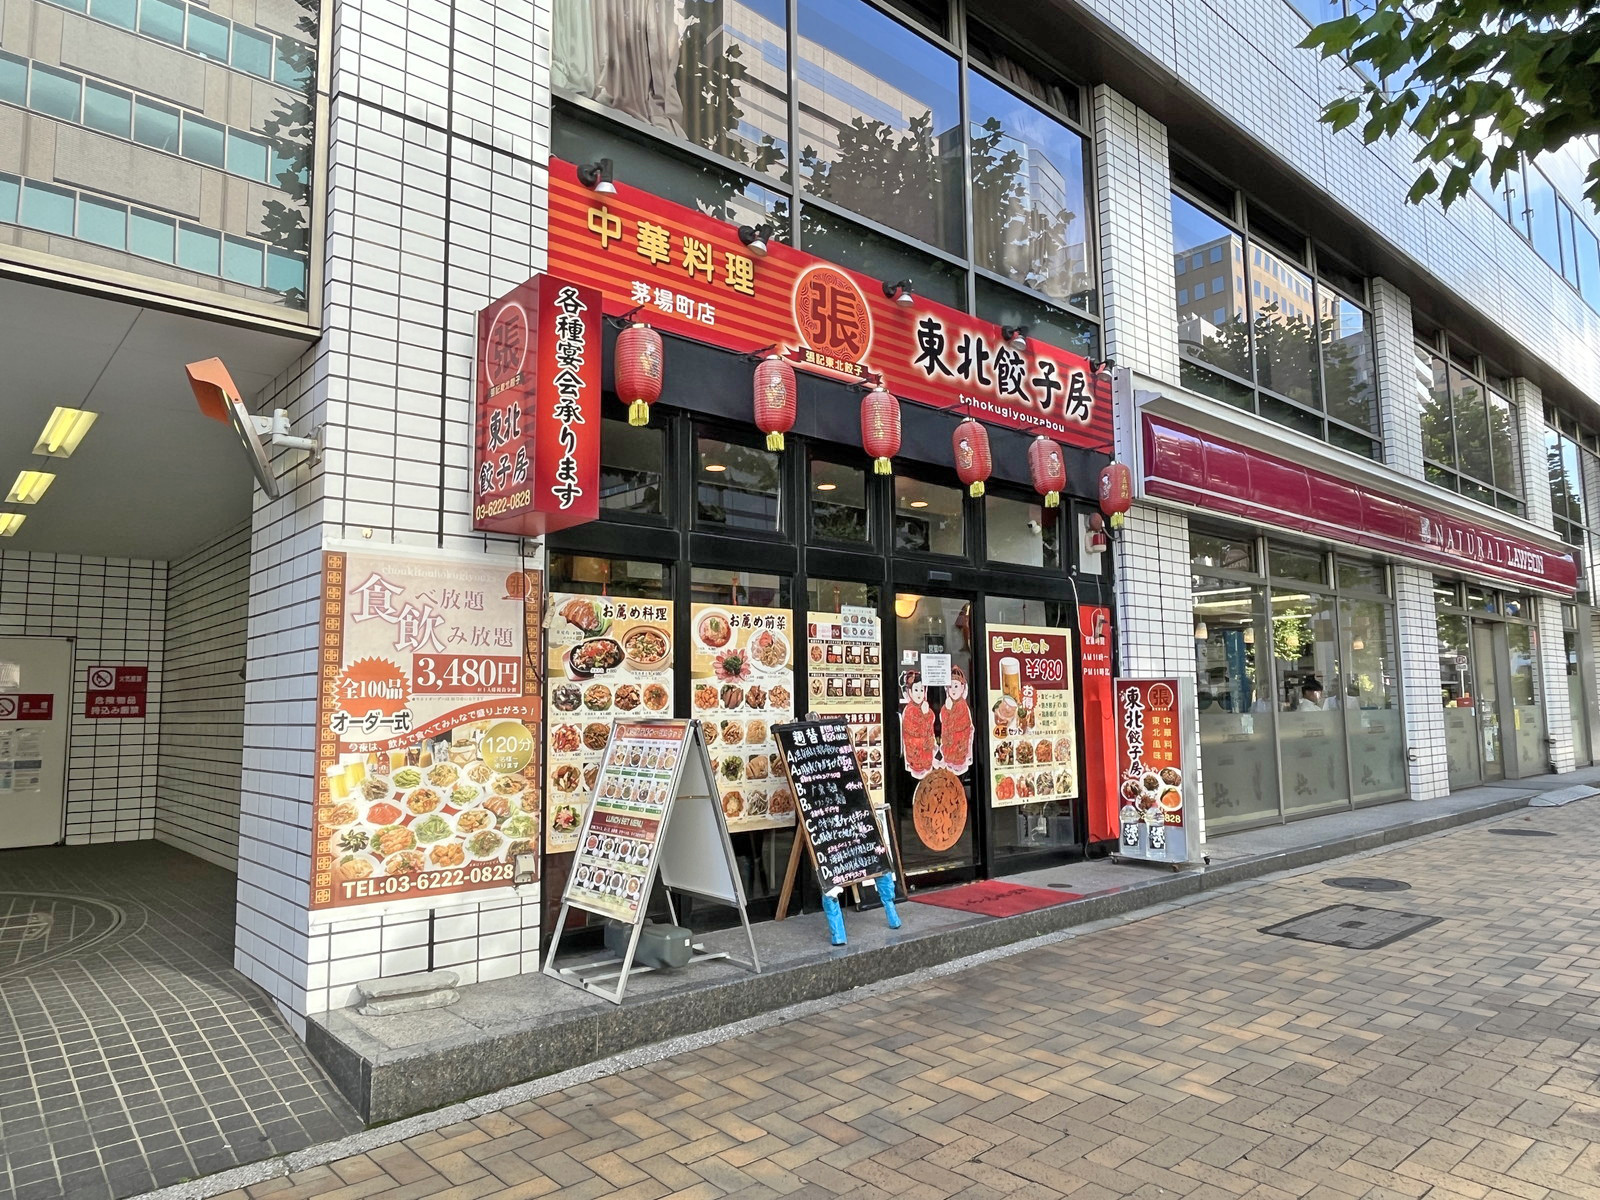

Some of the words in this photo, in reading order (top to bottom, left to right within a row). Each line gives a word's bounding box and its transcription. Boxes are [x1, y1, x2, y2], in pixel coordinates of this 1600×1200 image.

[587, 206, 755, 296] 中華料理
[630, 281, 717, 326] 茅場町店
[810, 281, 860, 352] 張
[805, 350, 863, 376] 張記東北餃子
[914, 317, 1092, 421] 東北餃子房
[553, 286, 587, 510] 各種宴会承ります
[488, 401, 521, 452] 東北
[478, 447, 530, 497] 餃子房
[476, 489, 531, 521] 03-6222-0828
[1434, 523, 1503, 562] NATURAL
[1507, 545, 1545, 575] LAWSON
[351, 573, 485, 624] 食べ放題
[602, 604, 668, 621] お薦め料理
[392, 602, 514, 653] 飲み放題
[729, 613, 786, 630] お薦め前菜
[992, 636, 1050, 655] ビールセット
[341, 678, 404, 700] 全100品
[418, 657, 519, 693] 3,480円
[1025, 658, 1063, 681] ¥980
[1152, 688, 1169, 706] 張
[331, 711, 411, 733] オーダー式
[486, 735, 532, 753] 120分
[1124, 687, 1145, 778] 東北餃子房
[1151, 716, 1162, 760] 東北風味
[1162, 717, 1173, 761] 中華料理
[342, 863, 515, 899] TEL:03-6222-0828
